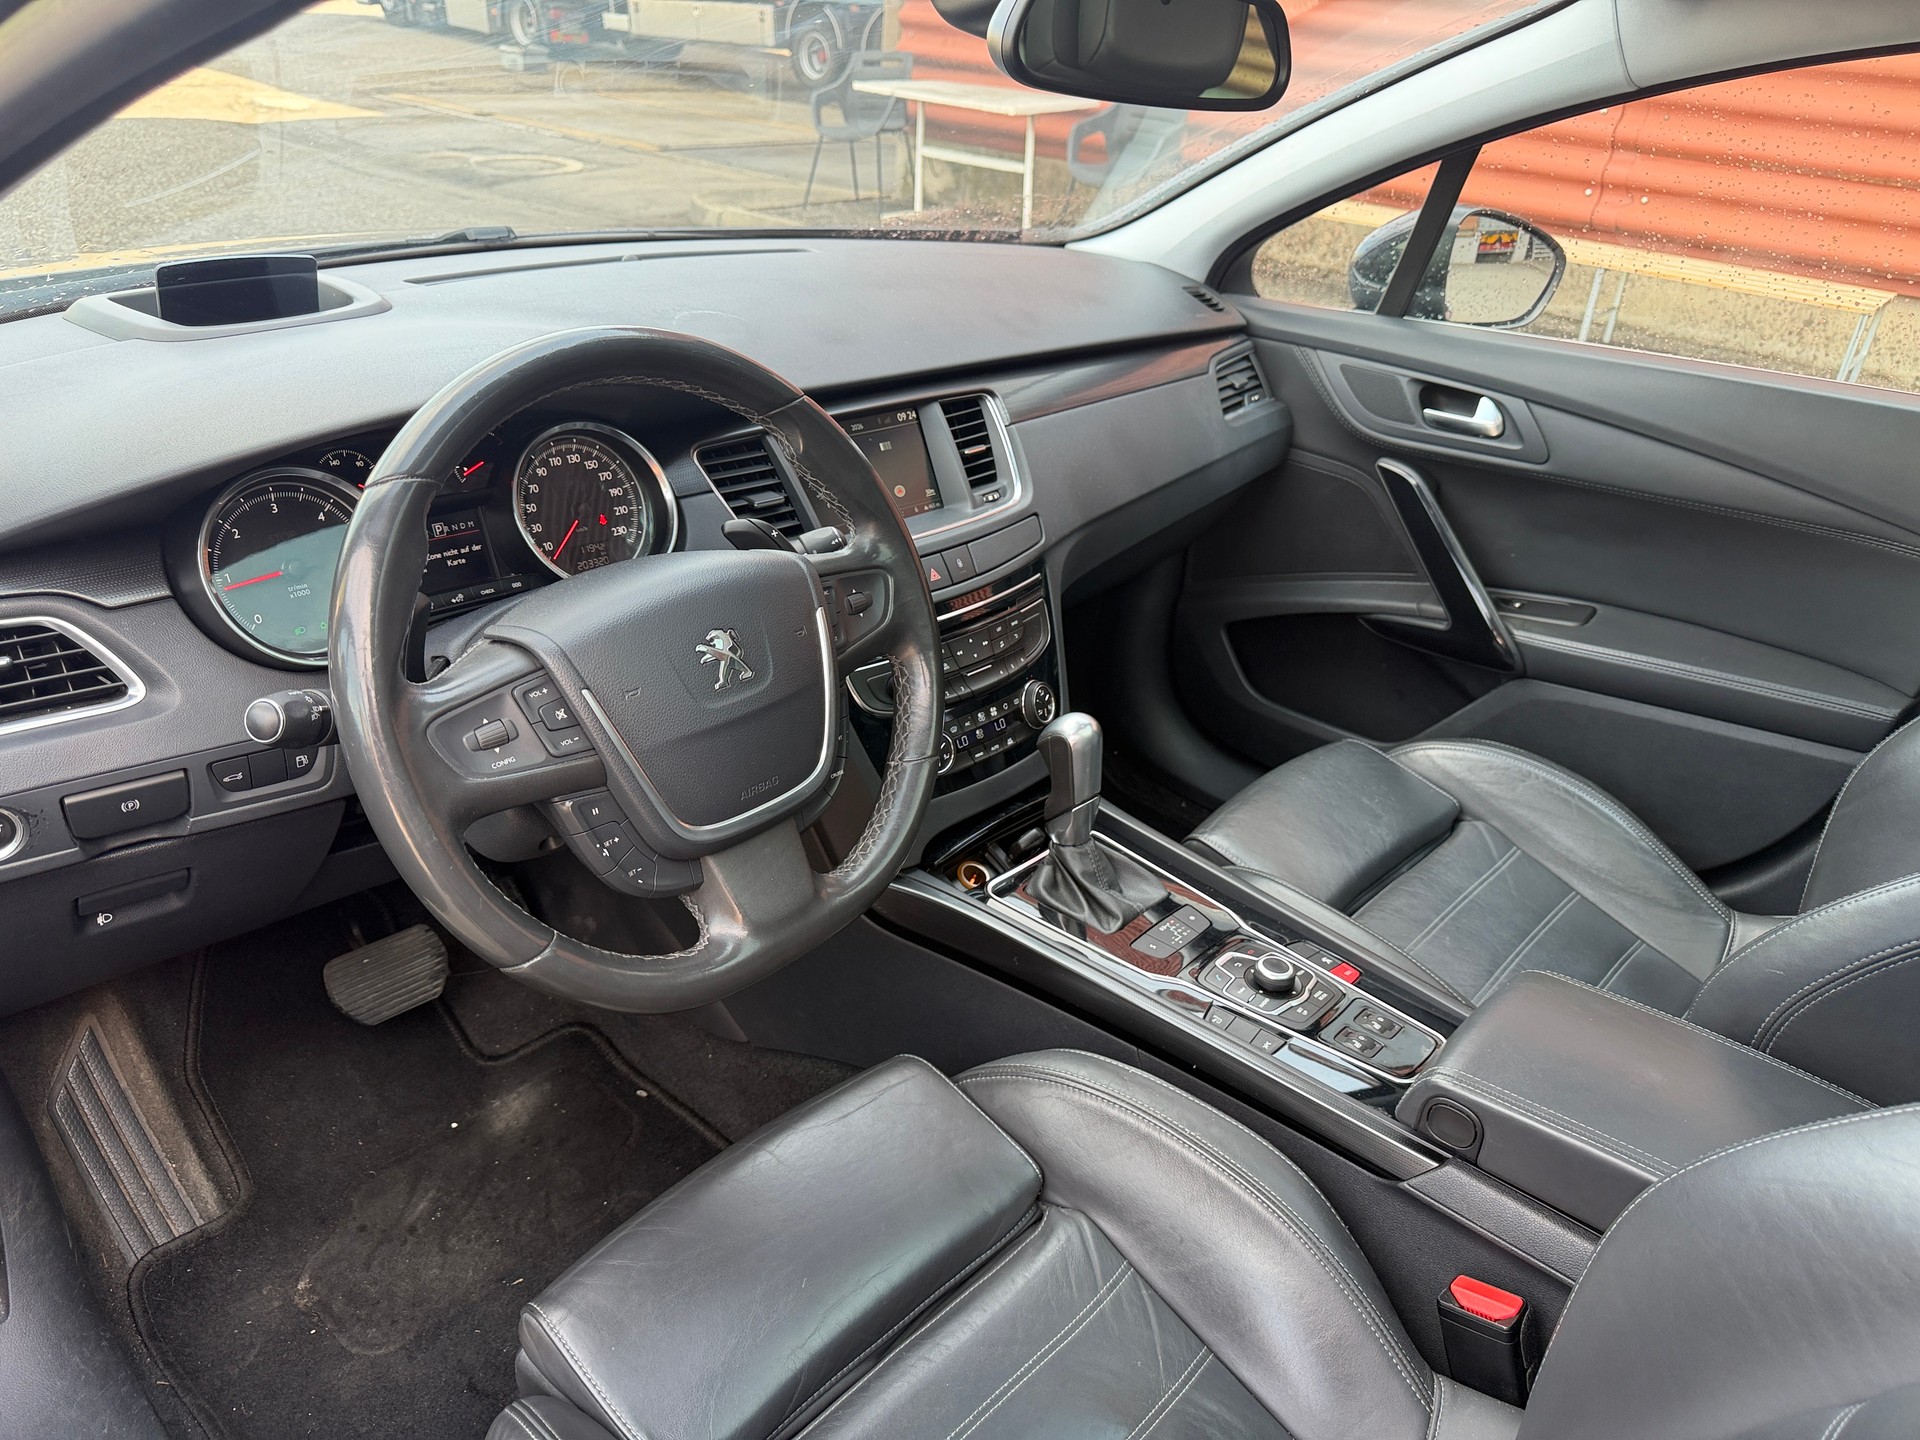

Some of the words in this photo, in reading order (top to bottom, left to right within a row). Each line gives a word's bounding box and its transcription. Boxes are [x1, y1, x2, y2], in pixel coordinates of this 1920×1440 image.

[328, 459, 341, 467] 140
[355, 460, 365, 468] 90
[548, 457, 562, 467] 110
[566, 453, 581, 464] 130
[583, 460, 599, 470] 150
[536, 467, 547, 476] 90
[598, 471, 613, 482] 170
[528, 484, 539, 493] 70
[608, 487, 623, 498] 190
[270, 503, 278, 514] 3
[525, 504, 537, 513] 50
[613, 505, 629, 516] 210
[317, 511, 326, 522] 4
[231, 528, 241, 539] 2
[435, 525, 443, 536] P
[451, 523, 459, 531] N
[460, 522, 466, 530] D
[531, 523, 542, 533] 30
[611, 525, 628, 536] 230
[443, 548, 459, 558] nicht
[460, 544, 470, 554] auf
[471, 544, 482, 552] der
[543, 542, 554, 551] 10
[446, 558, 467, 567] Karte
[577, 556, 610, 570] 203320
[224, 572, 231, 583] 1
[287, 583, 308, 592] tr/min
[289, 588, 311, 599] x1000
[253, 613, 263, 624] 0
[528, 690, 542, 699] VOL
[560, 739, 574, 747] VOL
[491, 756, 517, 769] CONFIG
[740, 775, 780, 801] AIRBAG
[603, 839, 613, 848] SET
[628, 868, 637, 877] SET
